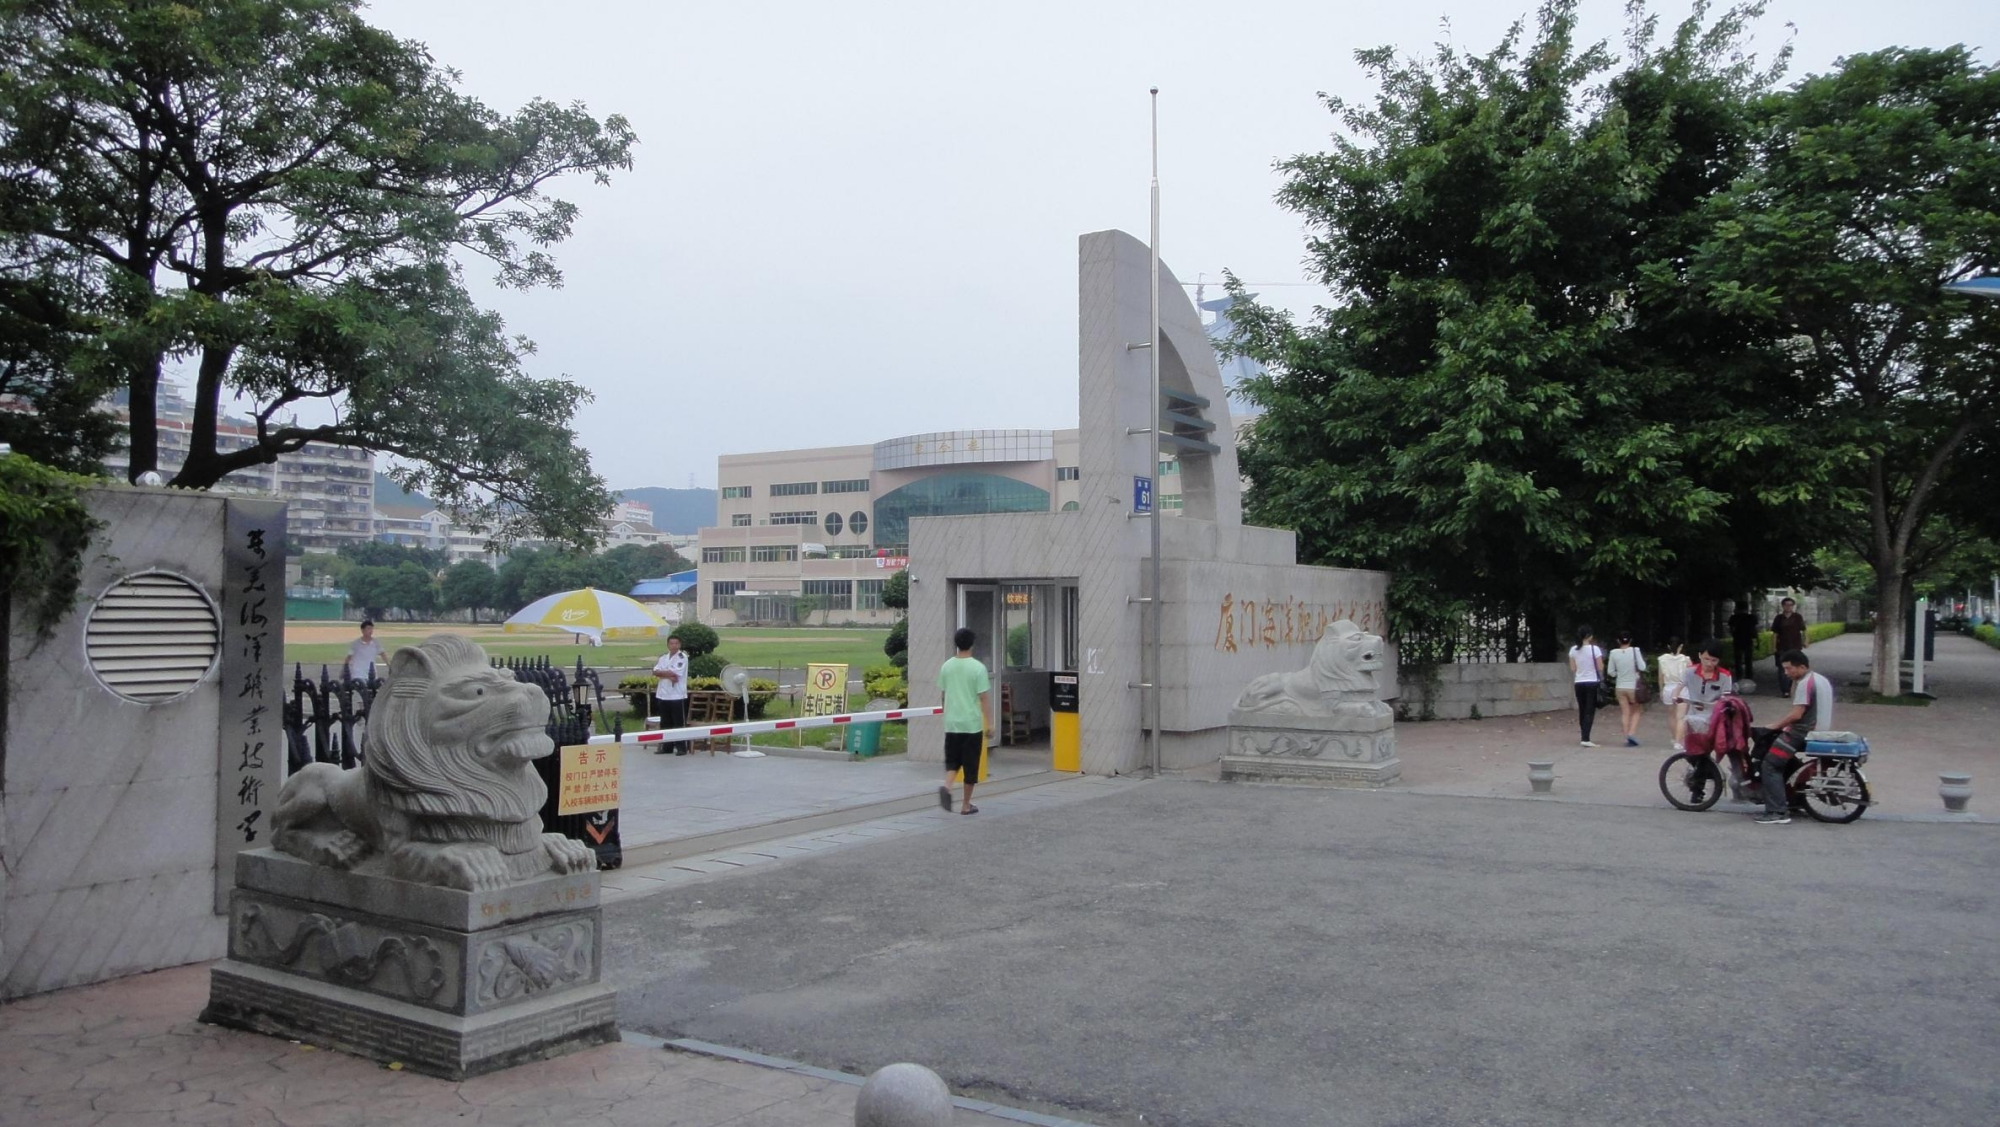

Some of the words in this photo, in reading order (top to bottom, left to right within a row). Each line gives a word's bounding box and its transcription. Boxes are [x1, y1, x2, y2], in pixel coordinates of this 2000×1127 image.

[1141, 490, 1150, 504] 61
[806, 693, 843, 717] 车位已满
[578, 749, 607, 766] 告示
